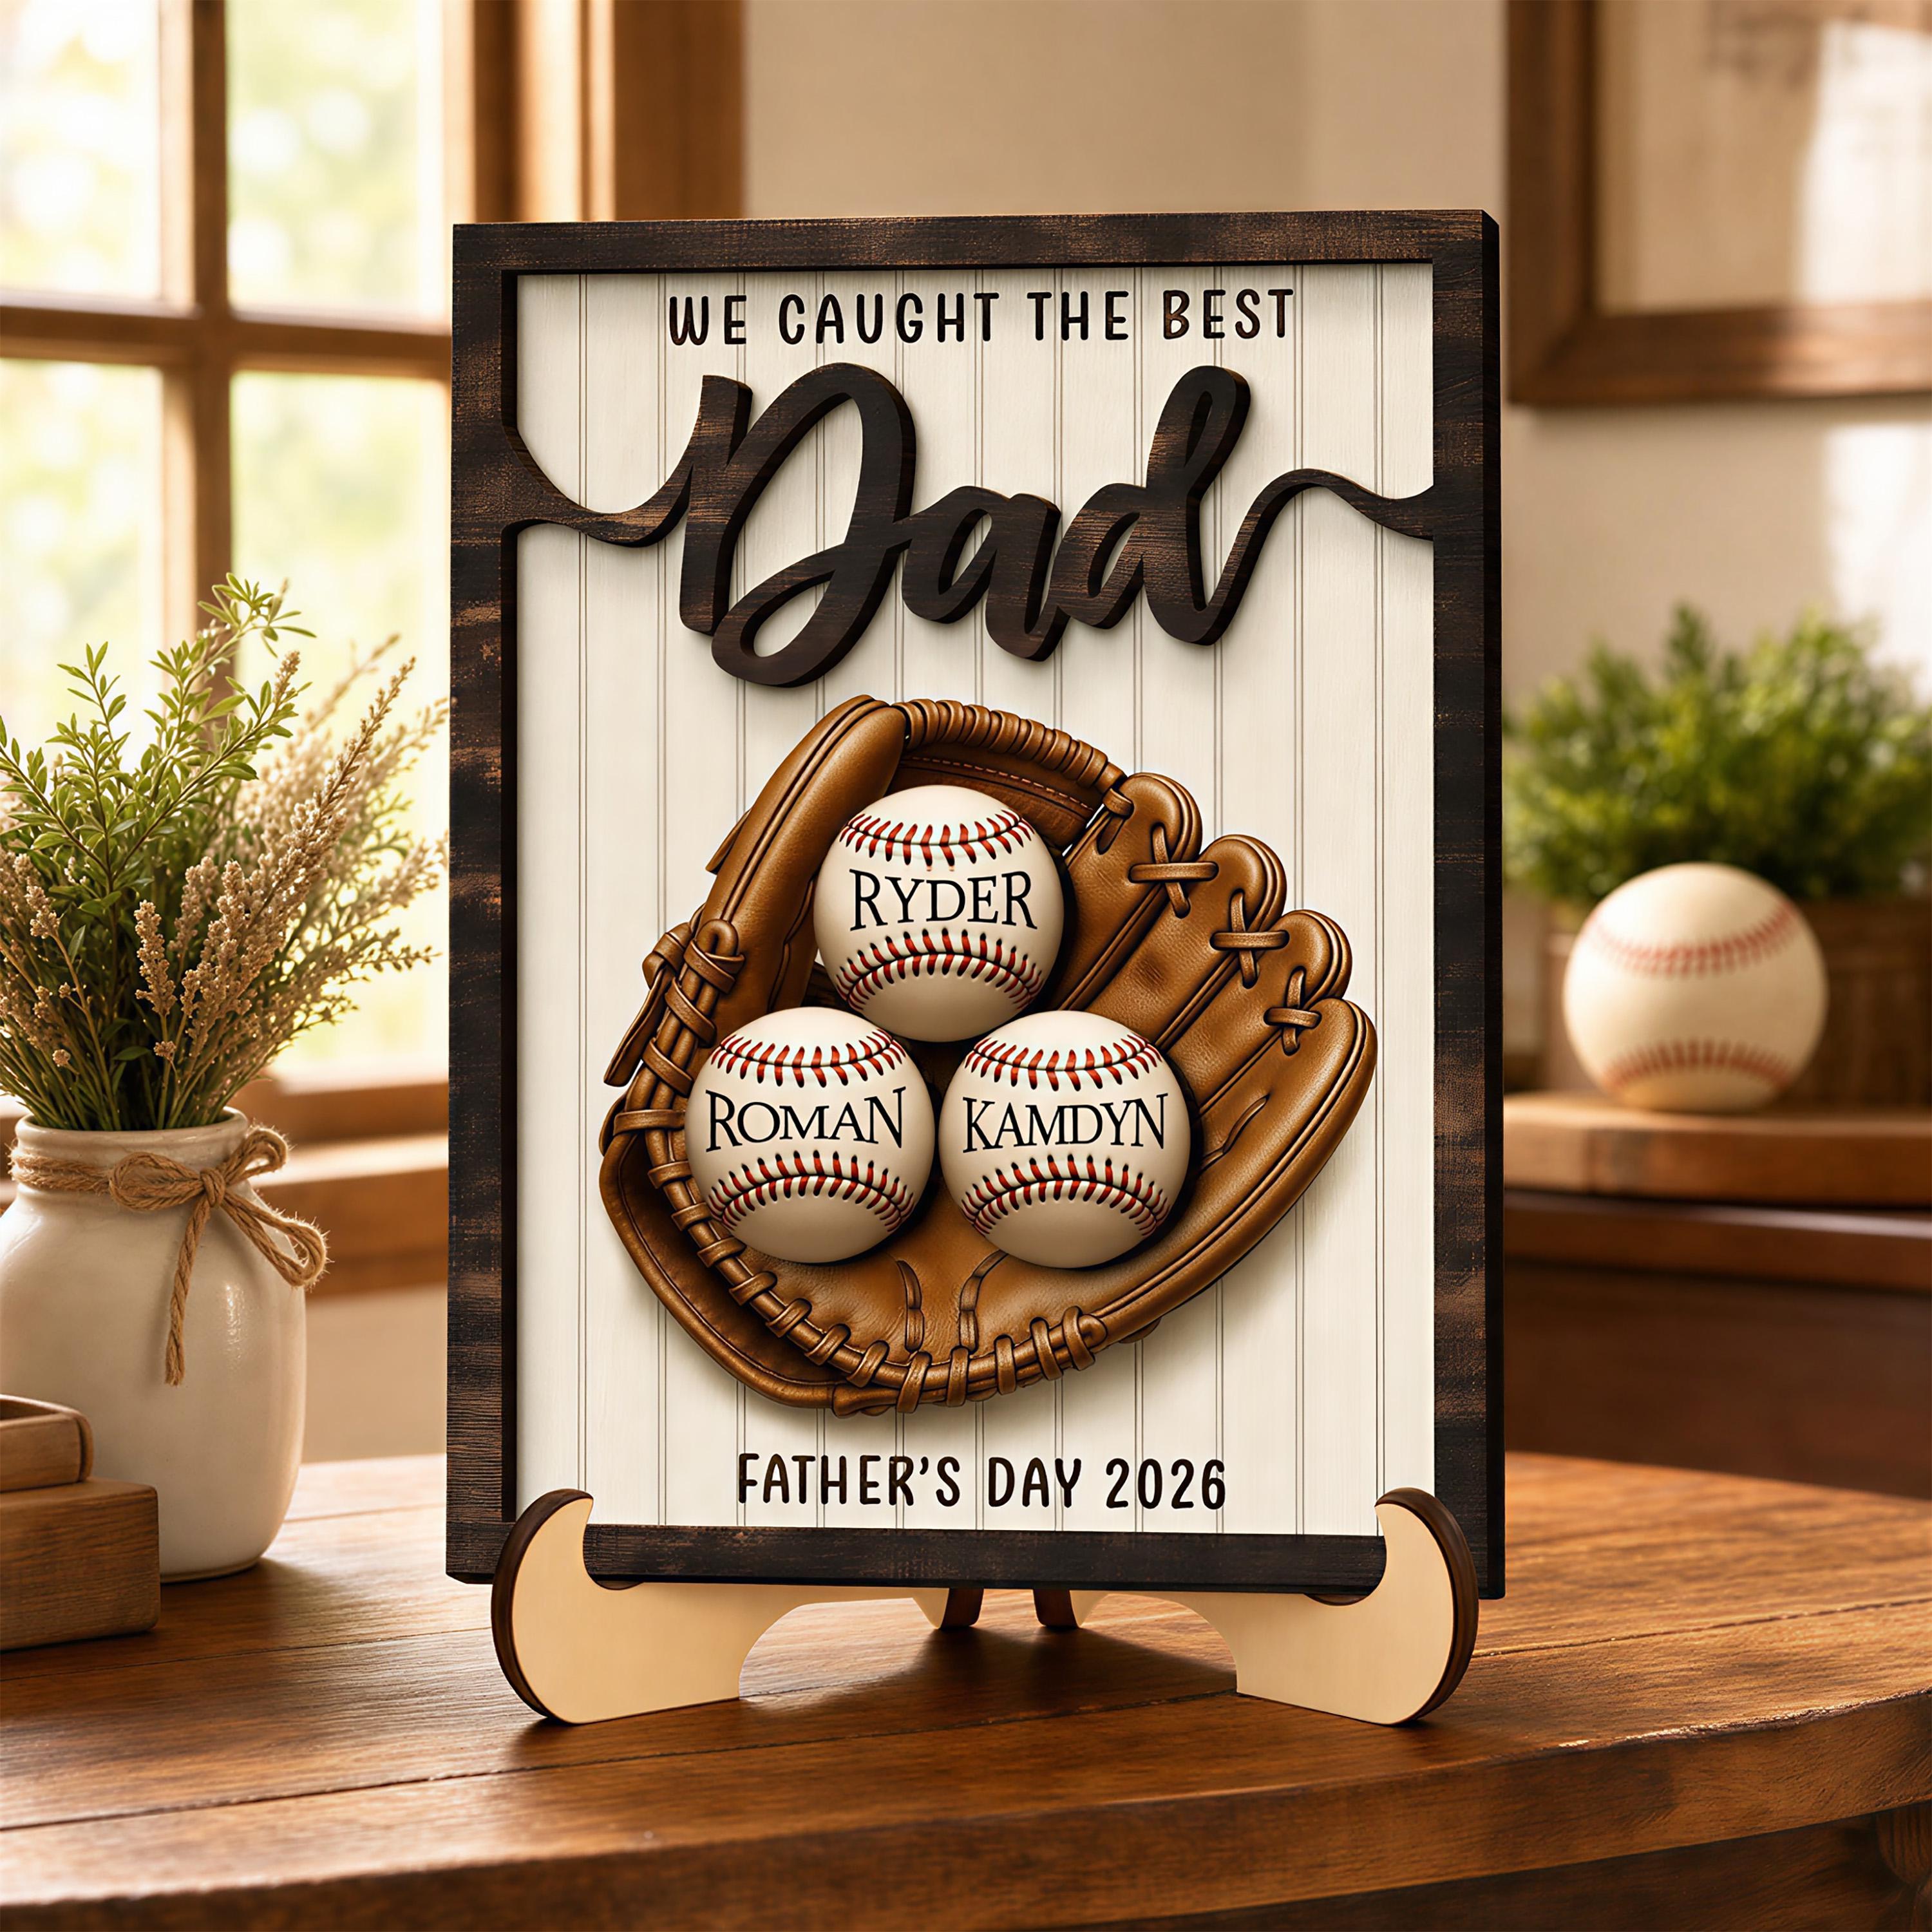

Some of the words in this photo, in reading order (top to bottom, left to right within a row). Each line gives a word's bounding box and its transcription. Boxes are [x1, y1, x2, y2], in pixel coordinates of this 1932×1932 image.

[669, 294, 747, 346] WE
[779, 292, 999, 345] CAUGHT
[1027, 290, 1129, 341] THE
[1162, 289, 1294, 340] BEST
[670, 362, 1262, 688] Dad
[849, 869, 1038, 931] RYDER
[705, 1086, 906, 1153] ROMAN
[962, 1093, 1169, 1153] KAMDYN
[988, 1457, 1082, 1508] DAY
[1106, 1458, 1226, 1510] 2026
